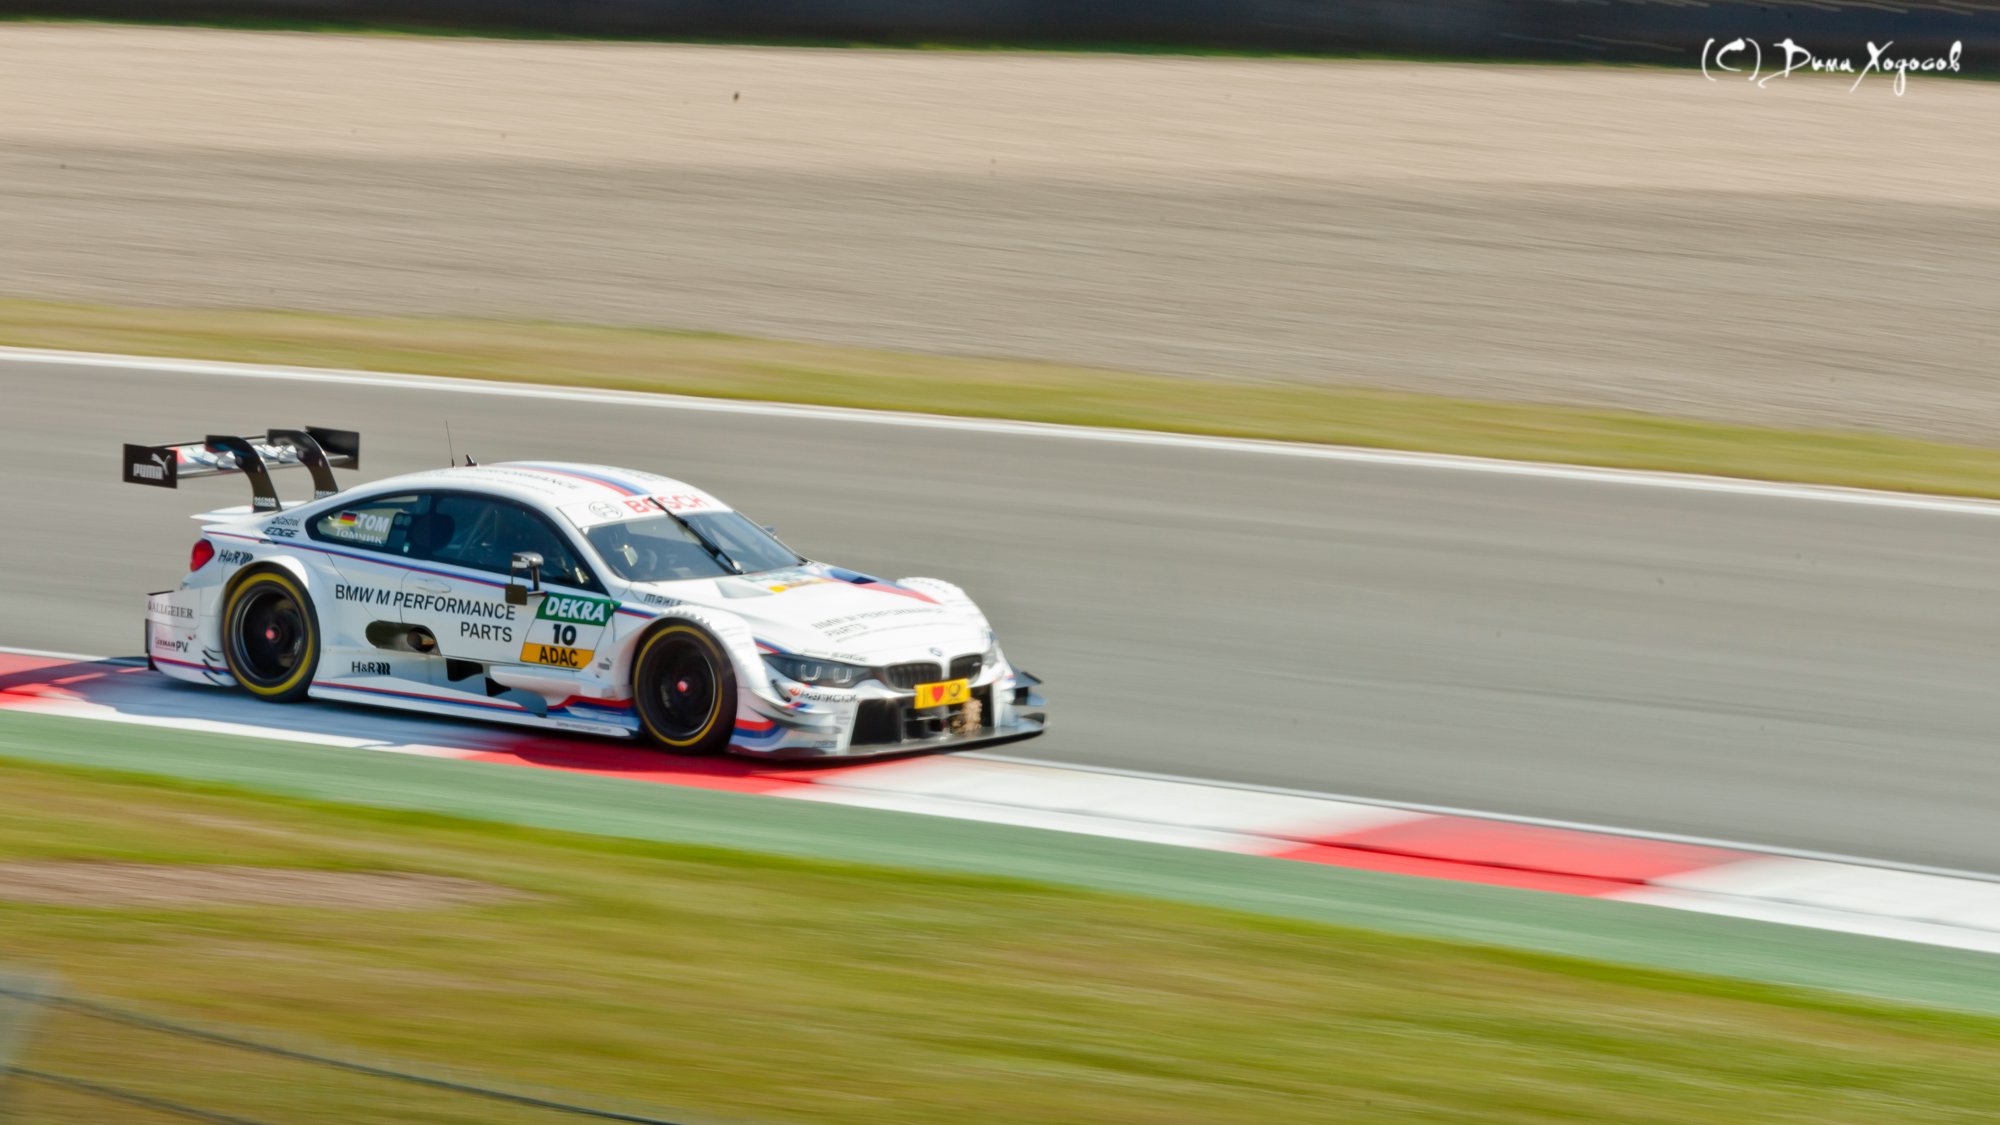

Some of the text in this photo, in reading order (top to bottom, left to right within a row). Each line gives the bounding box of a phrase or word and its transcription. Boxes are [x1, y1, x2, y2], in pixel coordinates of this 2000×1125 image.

[132, 462, 164, 481] PUMA
[623, 494, 711, 513] BOSCH
[263, 526, 299, 538] EDGE
[335, 584, 516, 621] BMW M PERFORMANCE
[545, 596, 605, 622] DEKRA
[460, 621, 513, 643] PARTS
[552, 623, 577, 646] 10
[539, 646, 579, 667] ADAC
[351, 660, 377, 675] H&R
